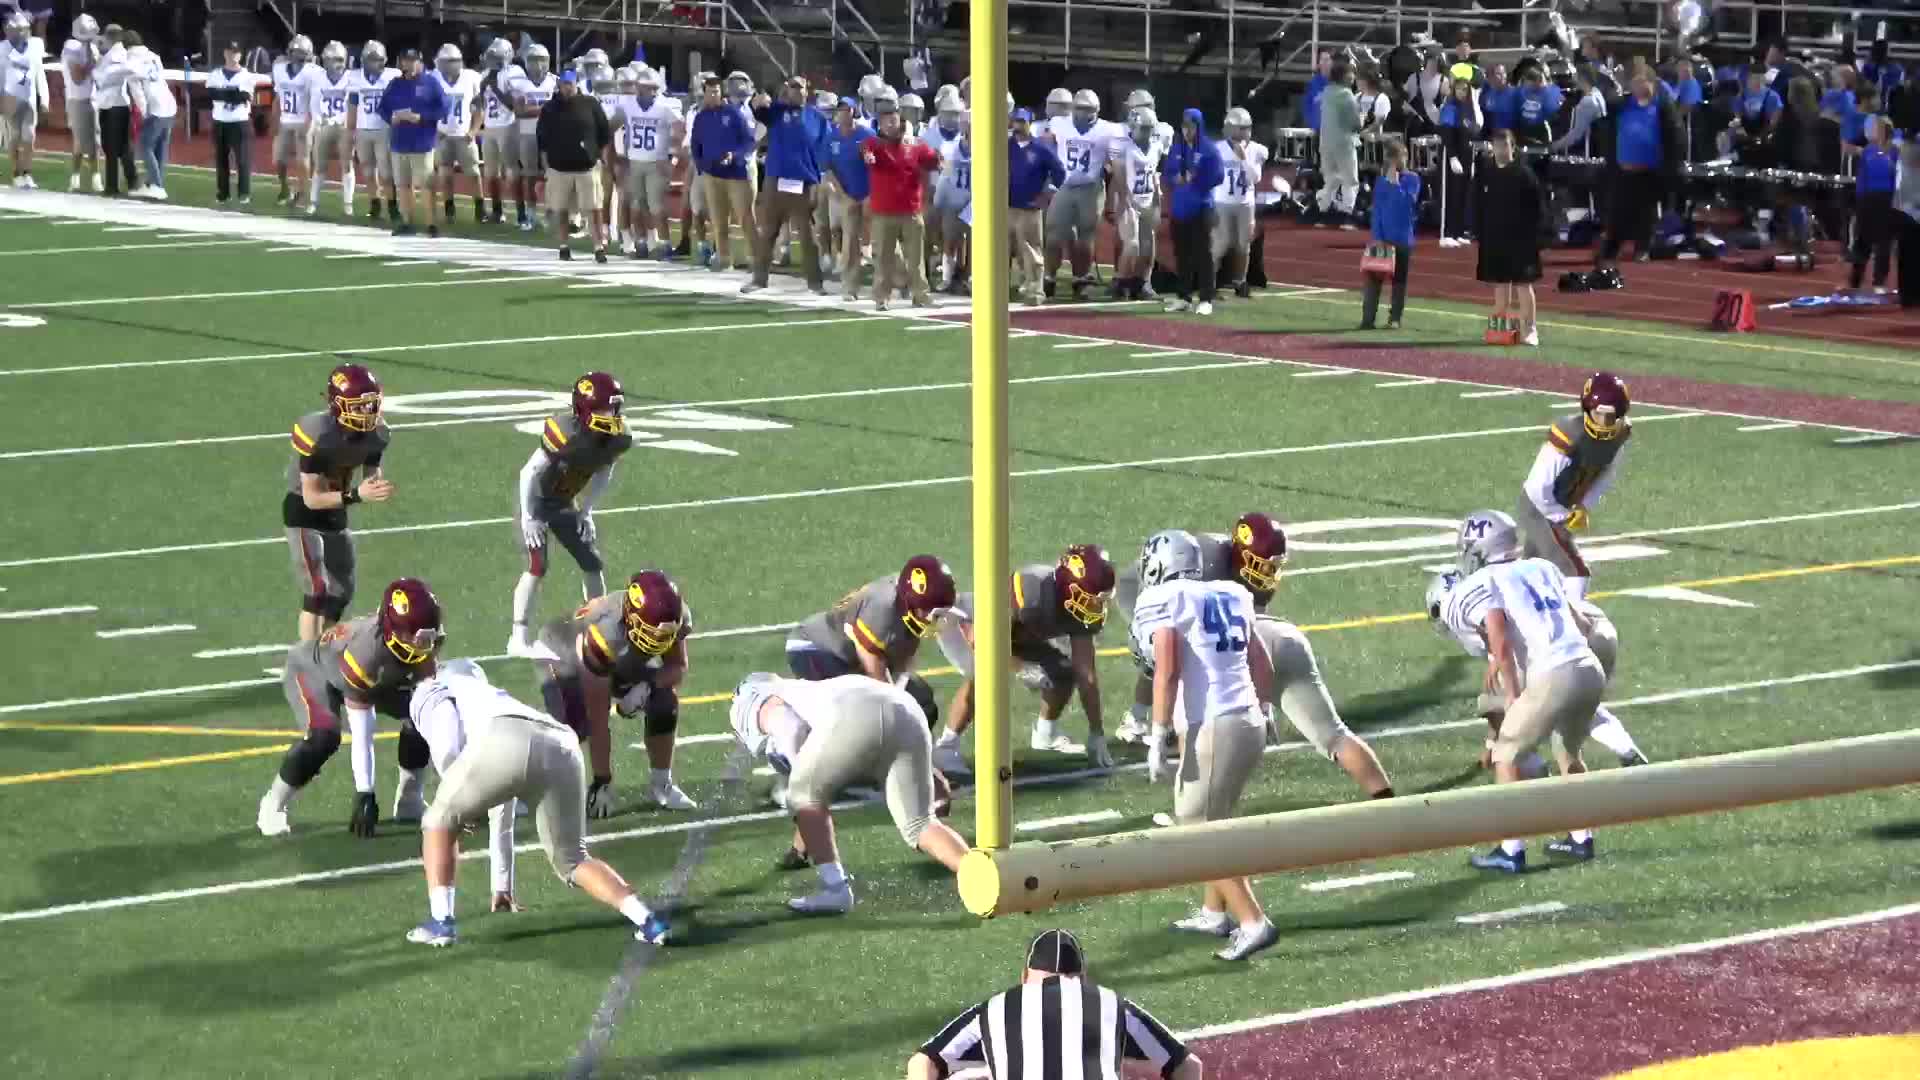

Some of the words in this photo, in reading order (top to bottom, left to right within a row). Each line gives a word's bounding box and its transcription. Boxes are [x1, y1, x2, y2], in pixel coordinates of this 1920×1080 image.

[631, 124, 657, 152] 56
[1066, 146, 1091, 174] 54
[1711, 290, 1743, 331] 20
[1202, 591, 1250, 653] 45
